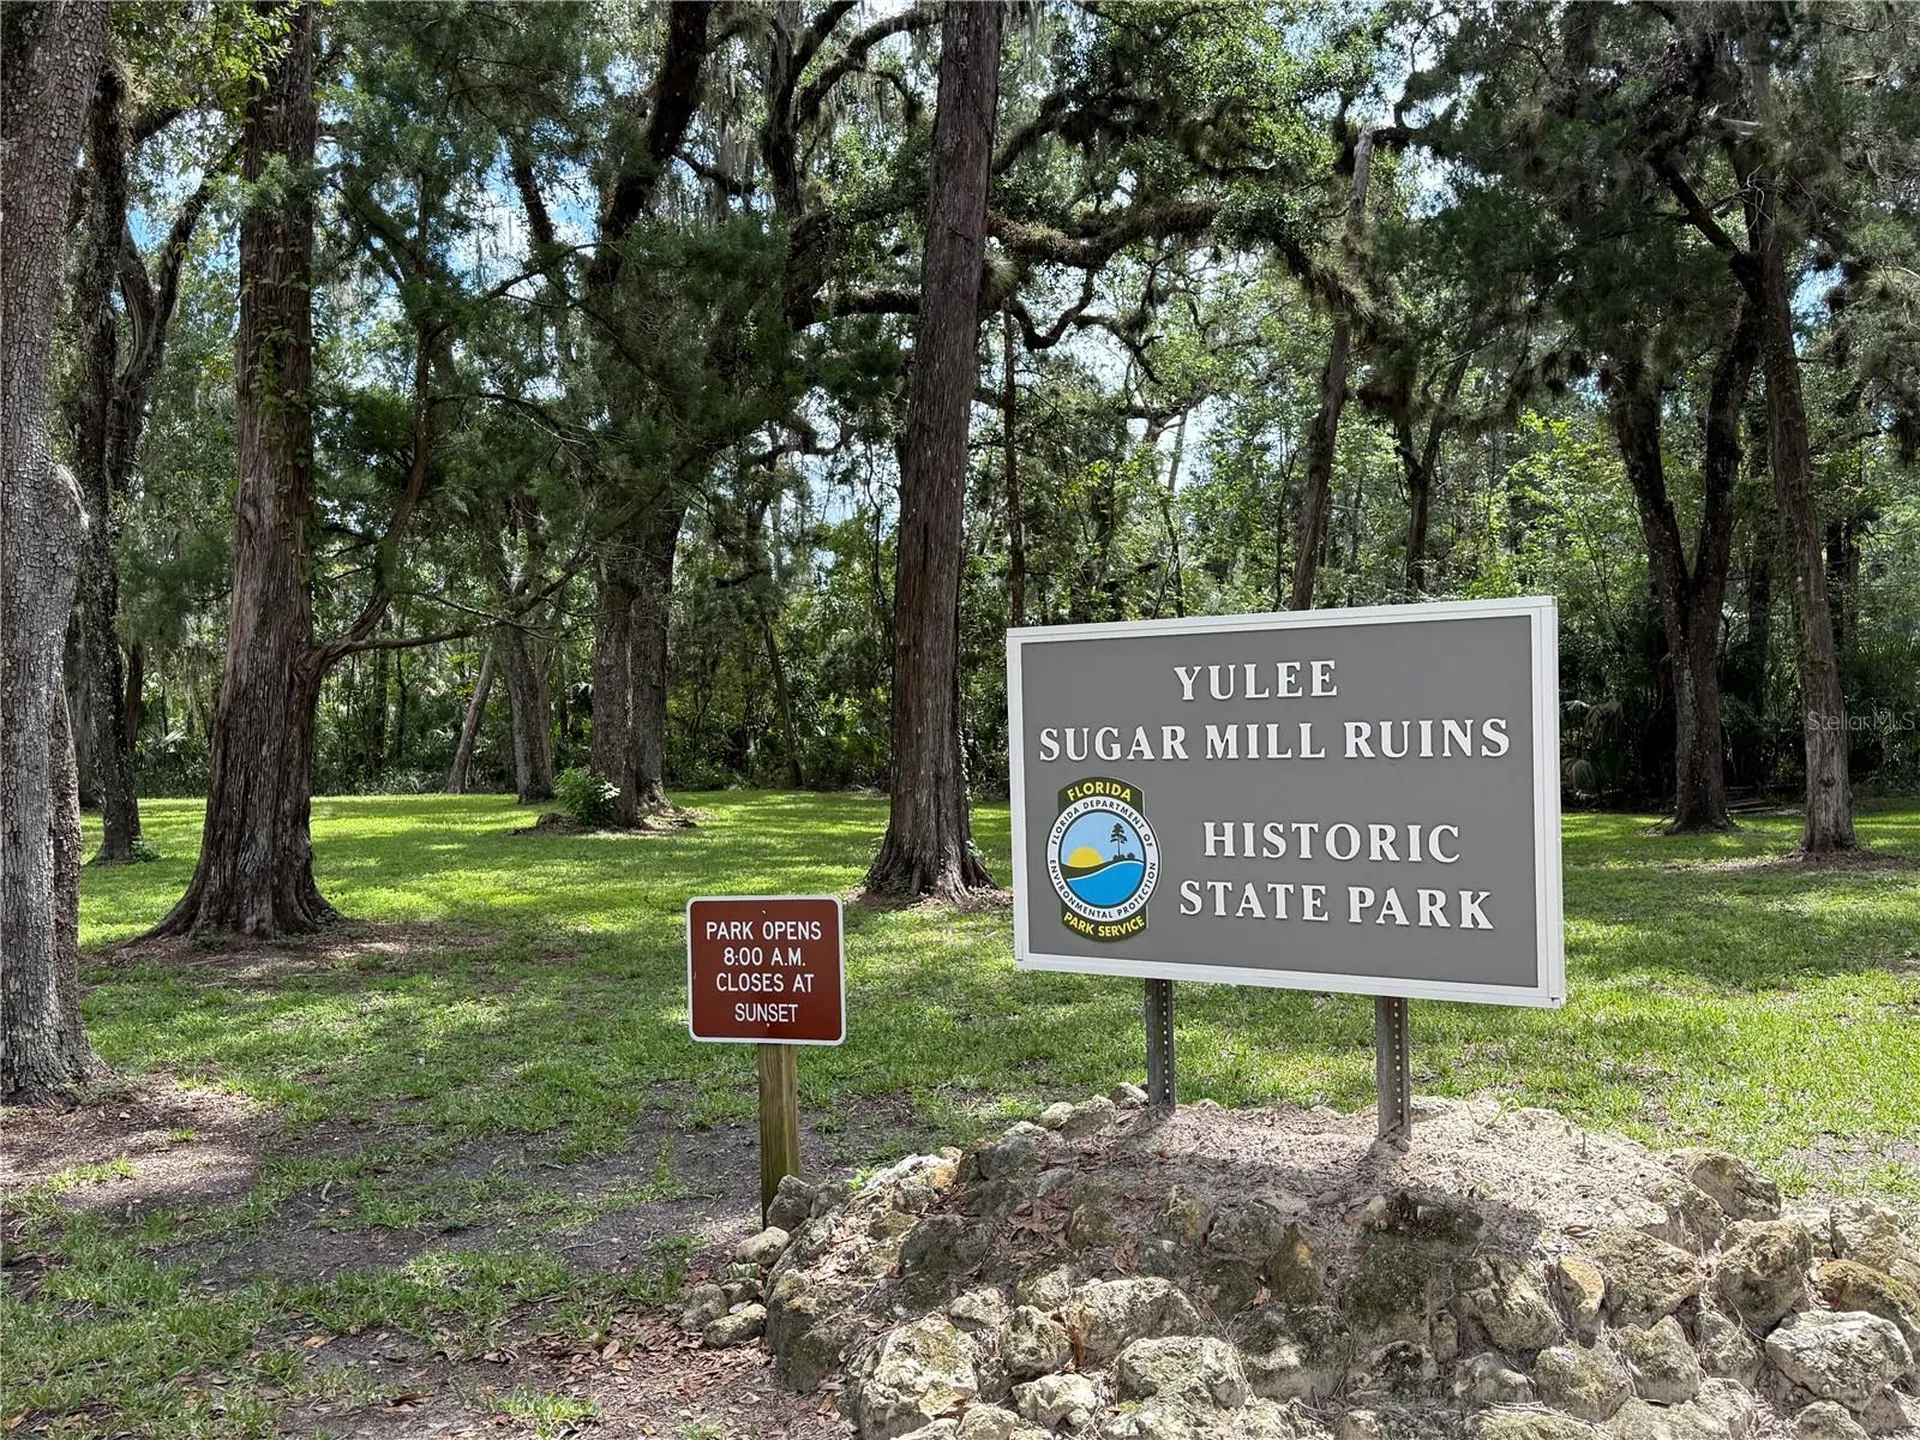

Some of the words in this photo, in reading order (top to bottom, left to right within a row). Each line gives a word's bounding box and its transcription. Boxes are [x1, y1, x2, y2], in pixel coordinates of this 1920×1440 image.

[1174, 660, 1339, 701] YULEE
[1039, 724, 1189, 762] SUGAR
[1205, 722, 1326, 760] MILL
[1343, 718, 1511, 758] RUINS
[1067, 781, 1132, 802] FLORIDA
[1051, 807, 1080, 846] FLORIDA
[1083, 799, 1145, 831] DEPARTMENT
[1143, 833, 1154, 848] OF
[1203, 821, 1461, 863] HISTORIC
[1050, 859, 1113, 919] ENVIRONMENTAL
[1117, 862, 1157, 917] PROTECTION
[1179, 879, 1329, 922] STATE
[1347, 886, 1495, 930] PARK
[706, 921, 754, 940] PARK
[762, 921, 822, 940] OPENS
[1063, 911, 1094, 936] PARK
[1098, 915, 1145, 937] SERVICE
[723, 947, 763, 966] 8:00
[771, 947, 806, 966] A.M.
[716, 972, 784, 992] CLOSES
[792, 973, 815, 993] AT
[734, 1003, 798, 1022] SUNSET
